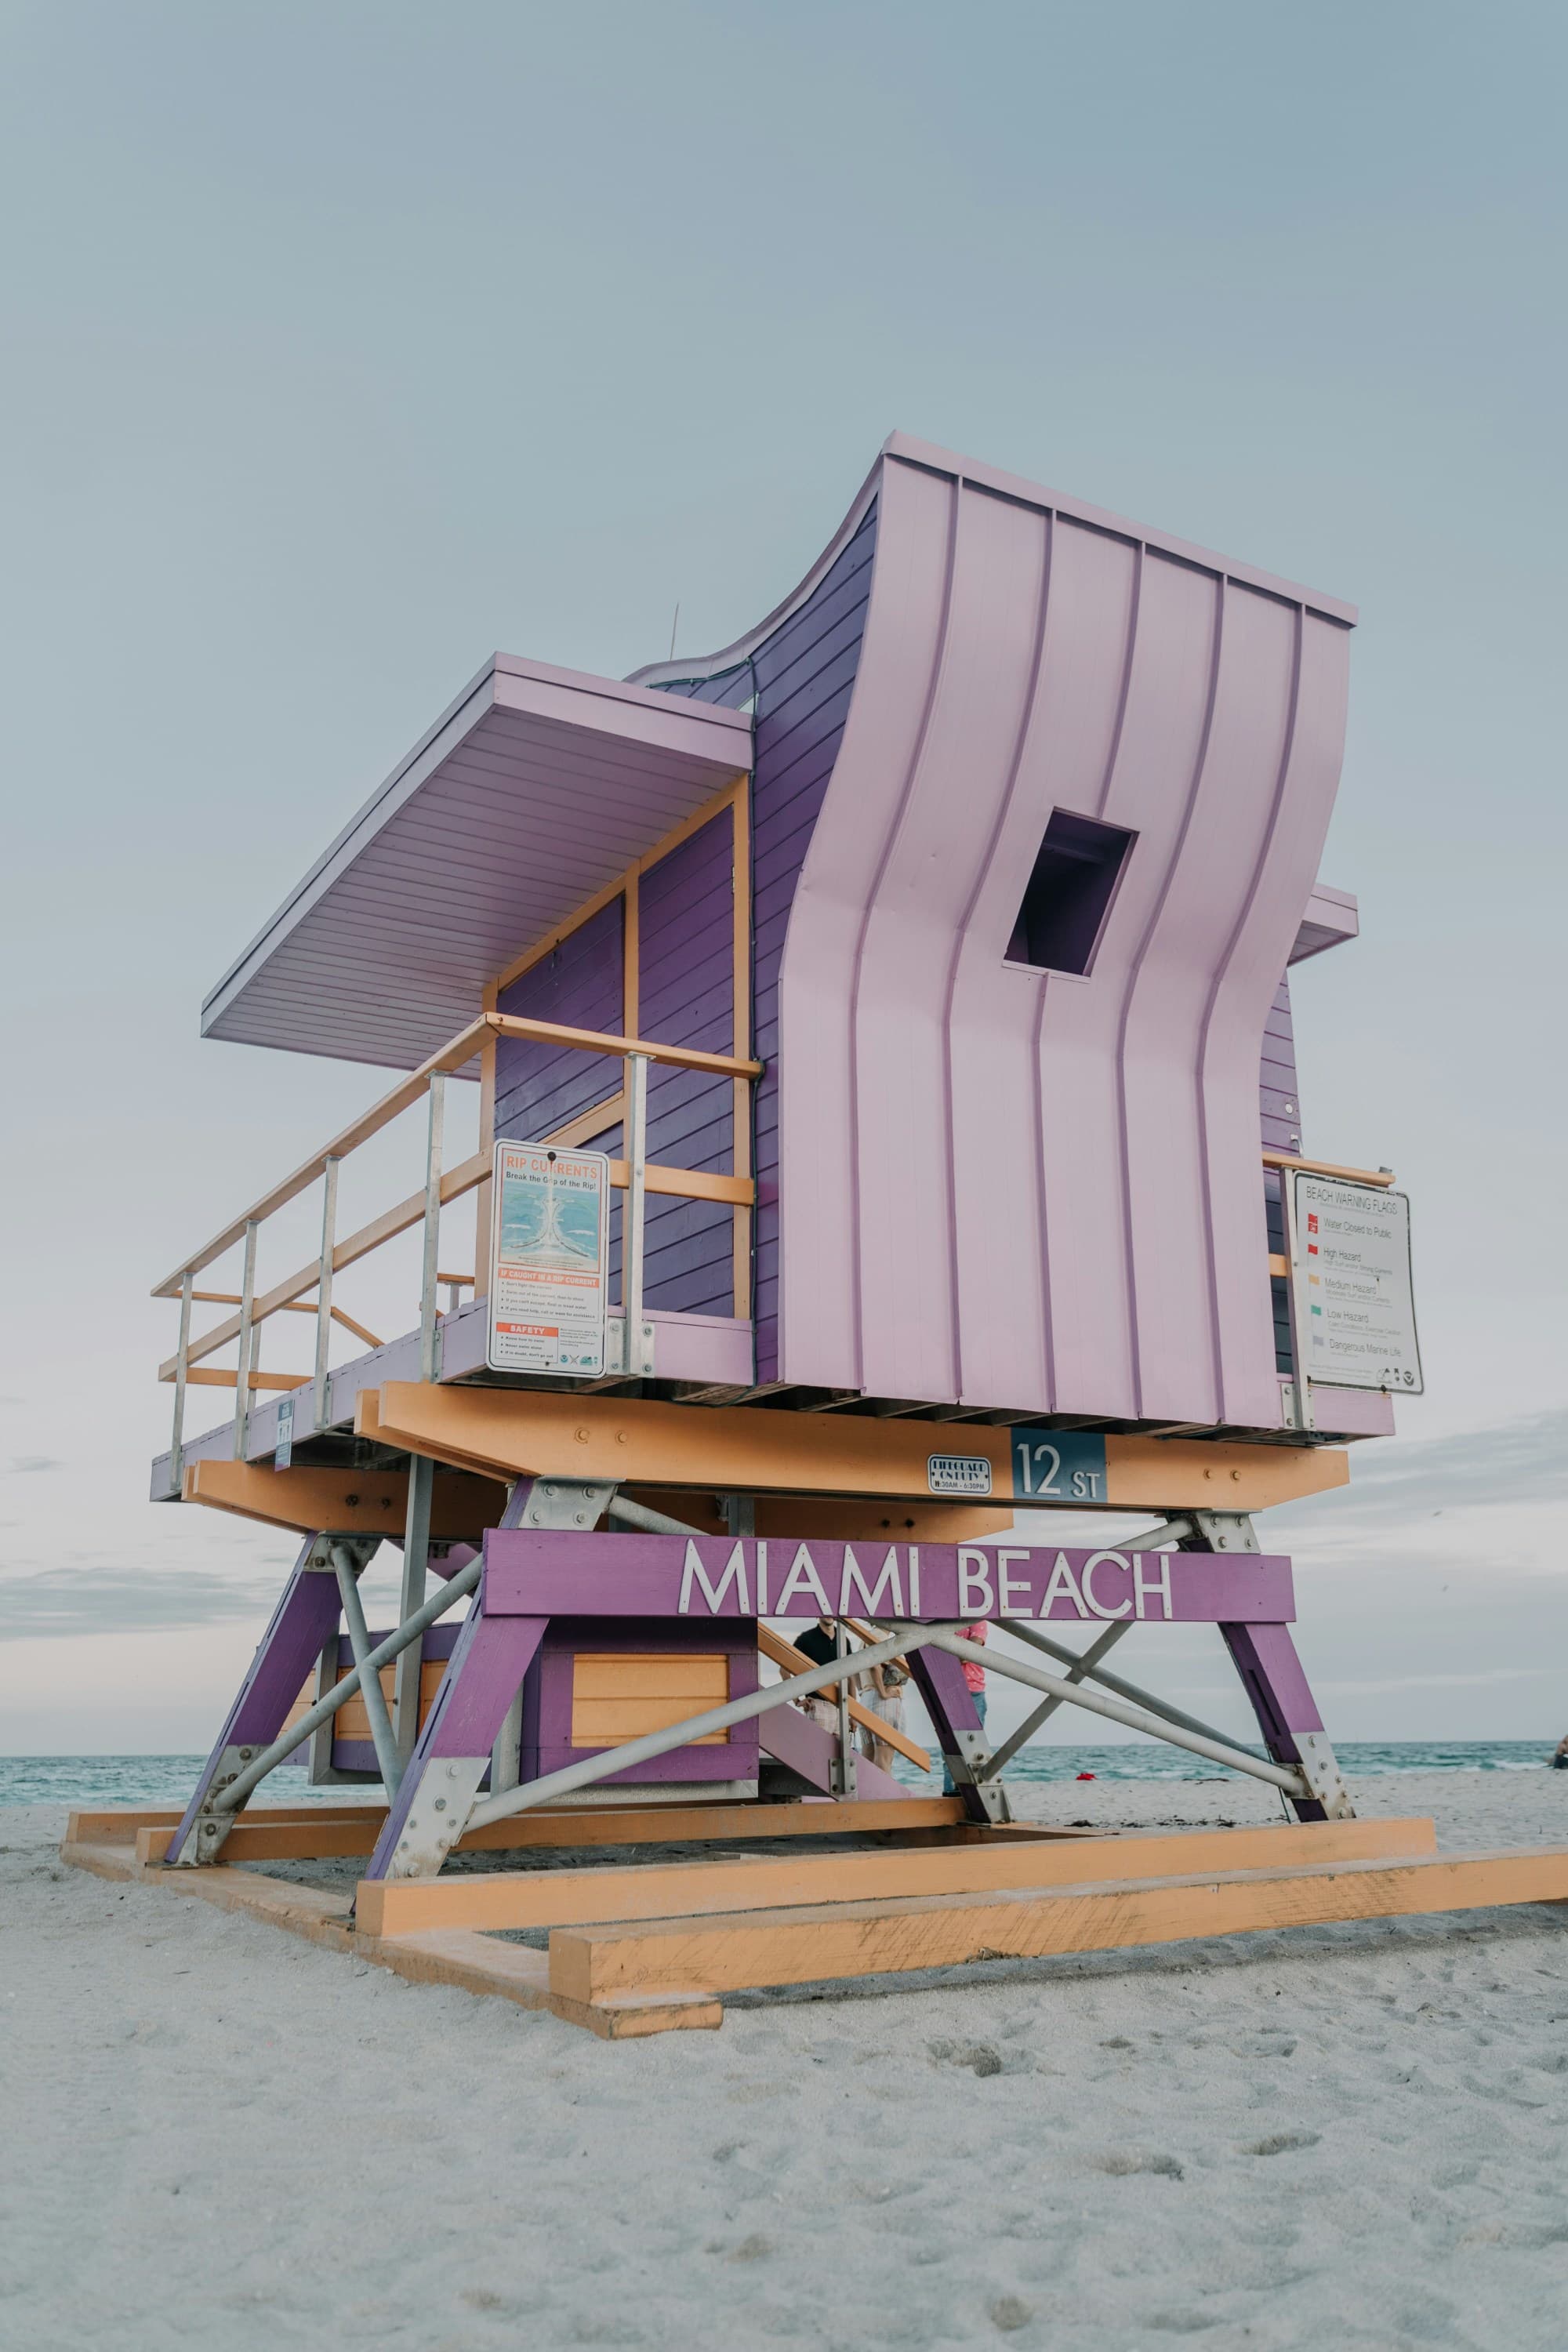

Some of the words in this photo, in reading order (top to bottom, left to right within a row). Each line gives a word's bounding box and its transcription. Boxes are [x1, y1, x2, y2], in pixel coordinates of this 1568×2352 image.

[506, 1156, 527, 1169] RIP
[506, 1171, 528, 1181] Break
[583, 1182, 597, 1191] Rip!
[1306, 1186, 1333, 1202] BEACH
[1335, 1192, 1371, 1210] WARNING
[1374, 1200, 1397, 1214] FLAGS
[1324, 1217, 1341, 1229] Water
[1344, 1221, 1365, 1234] Closed
[1374, 1226, 1392, 1239] Public
[1324, 1248, 1338, 1260] High
[1339, 1250, 1361, 1262] Hazard
[510, 1270, 536, 1279] CAUGHT
[564, 1277, 597, 1286] CURRENT
[1325, 1278, 1352, 1290] Medium
[1352, 1283, 1377, 1294] Hazard
[1327, 1308, 1341, 1319] Low
[1343, 1310, 1369, 1323] Hazard
[510, 1325, 545, 1334] SAFETY
[1329, 1338, 1366, 1352] Dangerous
[1367, 1344, 1388, 1356] Marine
[1390, 1347, 1402, 1358] Life
[934, 1461, 986, 1472] LIFEGUARD
[1017, 1443, 1061, 1494] 12
[1073, 1471, 1101, 1498] ST
[940, 1471, 953, 1479] ON
[955, 1472, 979, 1480] DUTY
[678, 1538, 920, 1617] MIAMI
[957, 1548, 1173, 1619] BEACH
